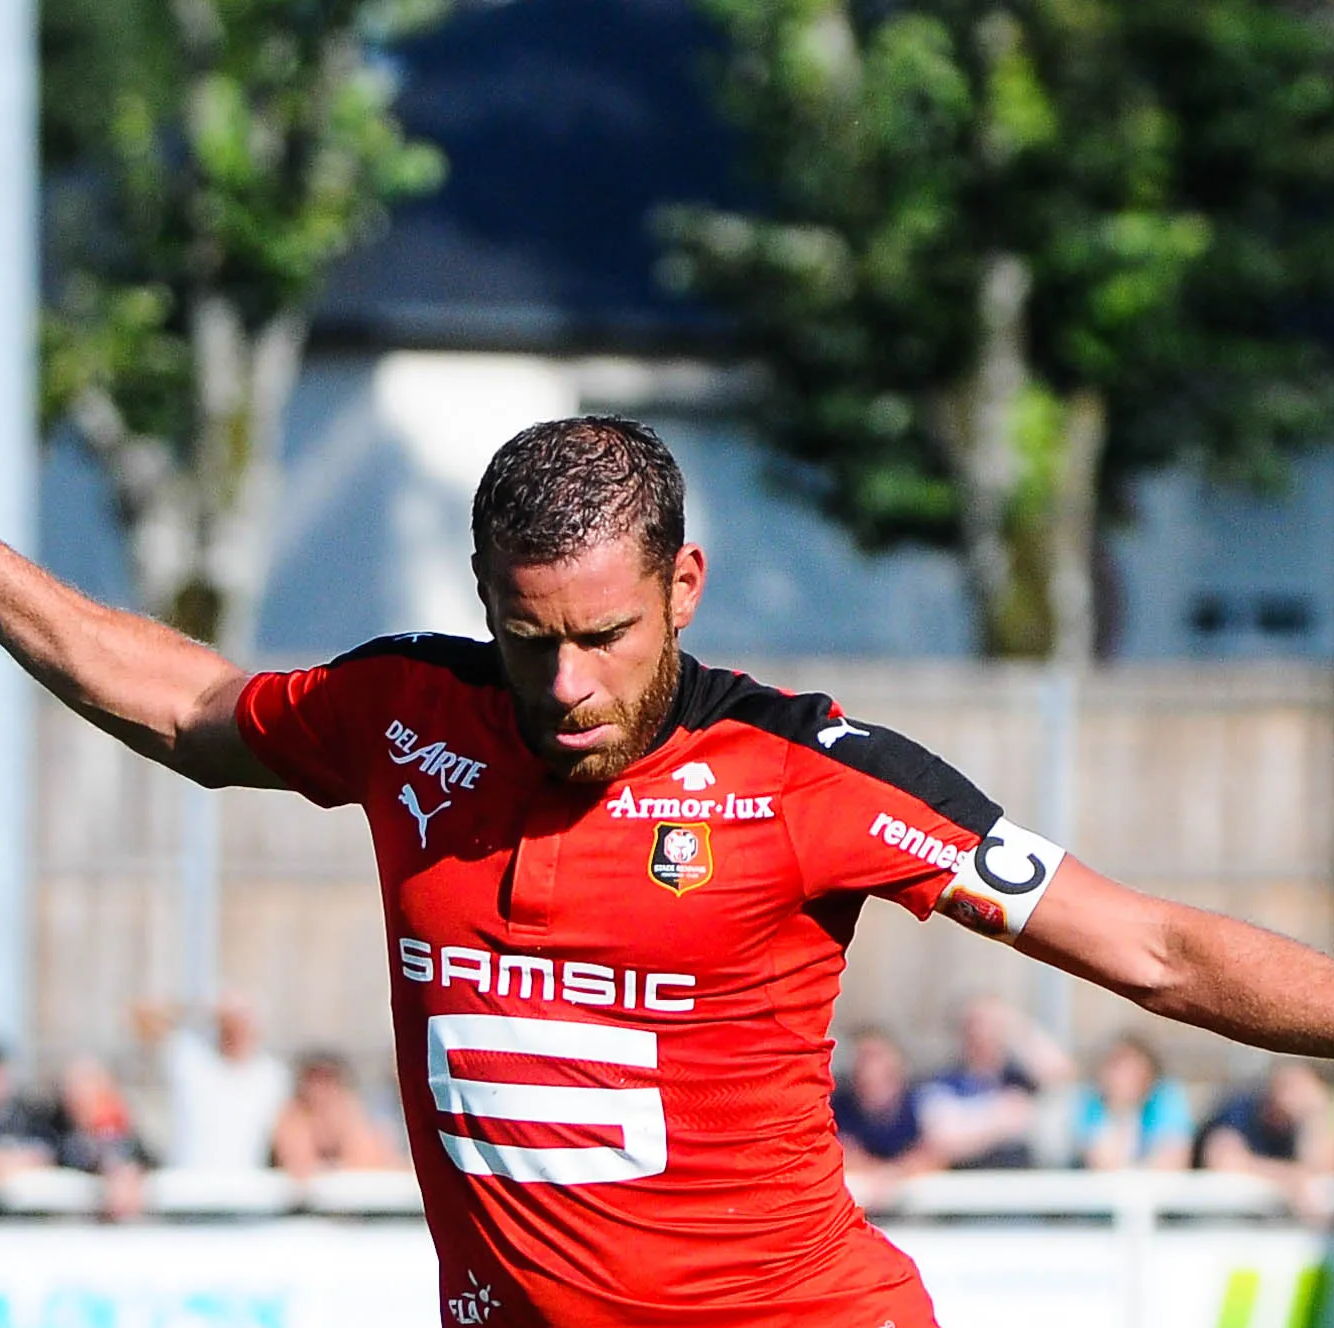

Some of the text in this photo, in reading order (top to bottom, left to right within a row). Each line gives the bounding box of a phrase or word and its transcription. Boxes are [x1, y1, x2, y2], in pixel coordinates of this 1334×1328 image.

[385, 720, 487, 793] DEL ARTE
[869, 812, 970, 874] rennes
[974, 836, 1046, 895] C
[399, 938, 695, 1012] SAMSIC
